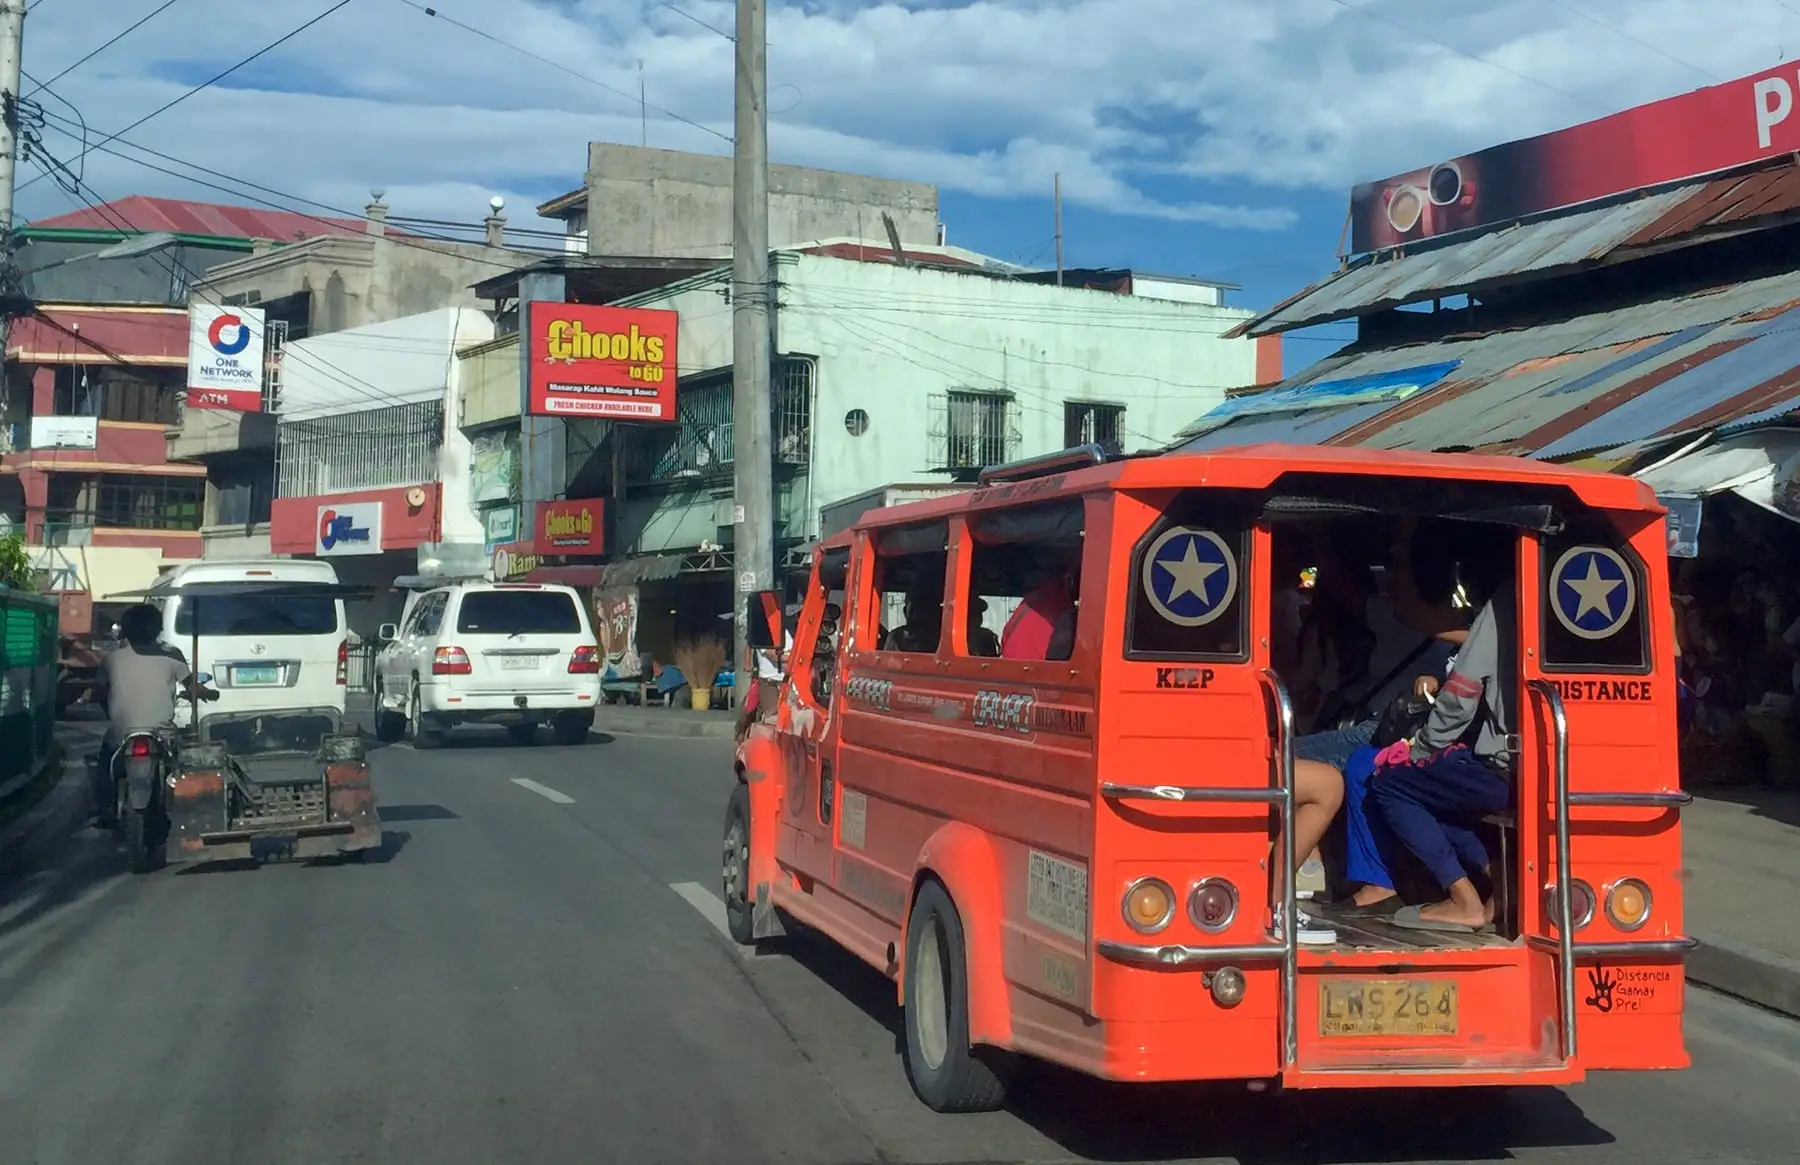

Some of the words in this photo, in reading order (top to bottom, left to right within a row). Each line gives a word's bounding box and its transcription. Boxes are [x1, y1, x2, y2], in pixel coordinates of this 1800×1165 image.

[1754, 69, 1800, 149] P
[546, 319, 665, 363] Chooks
[215, 357, 239, 368] ONE
[200, 366, 254, 378] NETWORK
[629, 366, 642, 379] to
[199, 393, 228, 404] ATM
[1394, 985, 1452, 1017] 264
